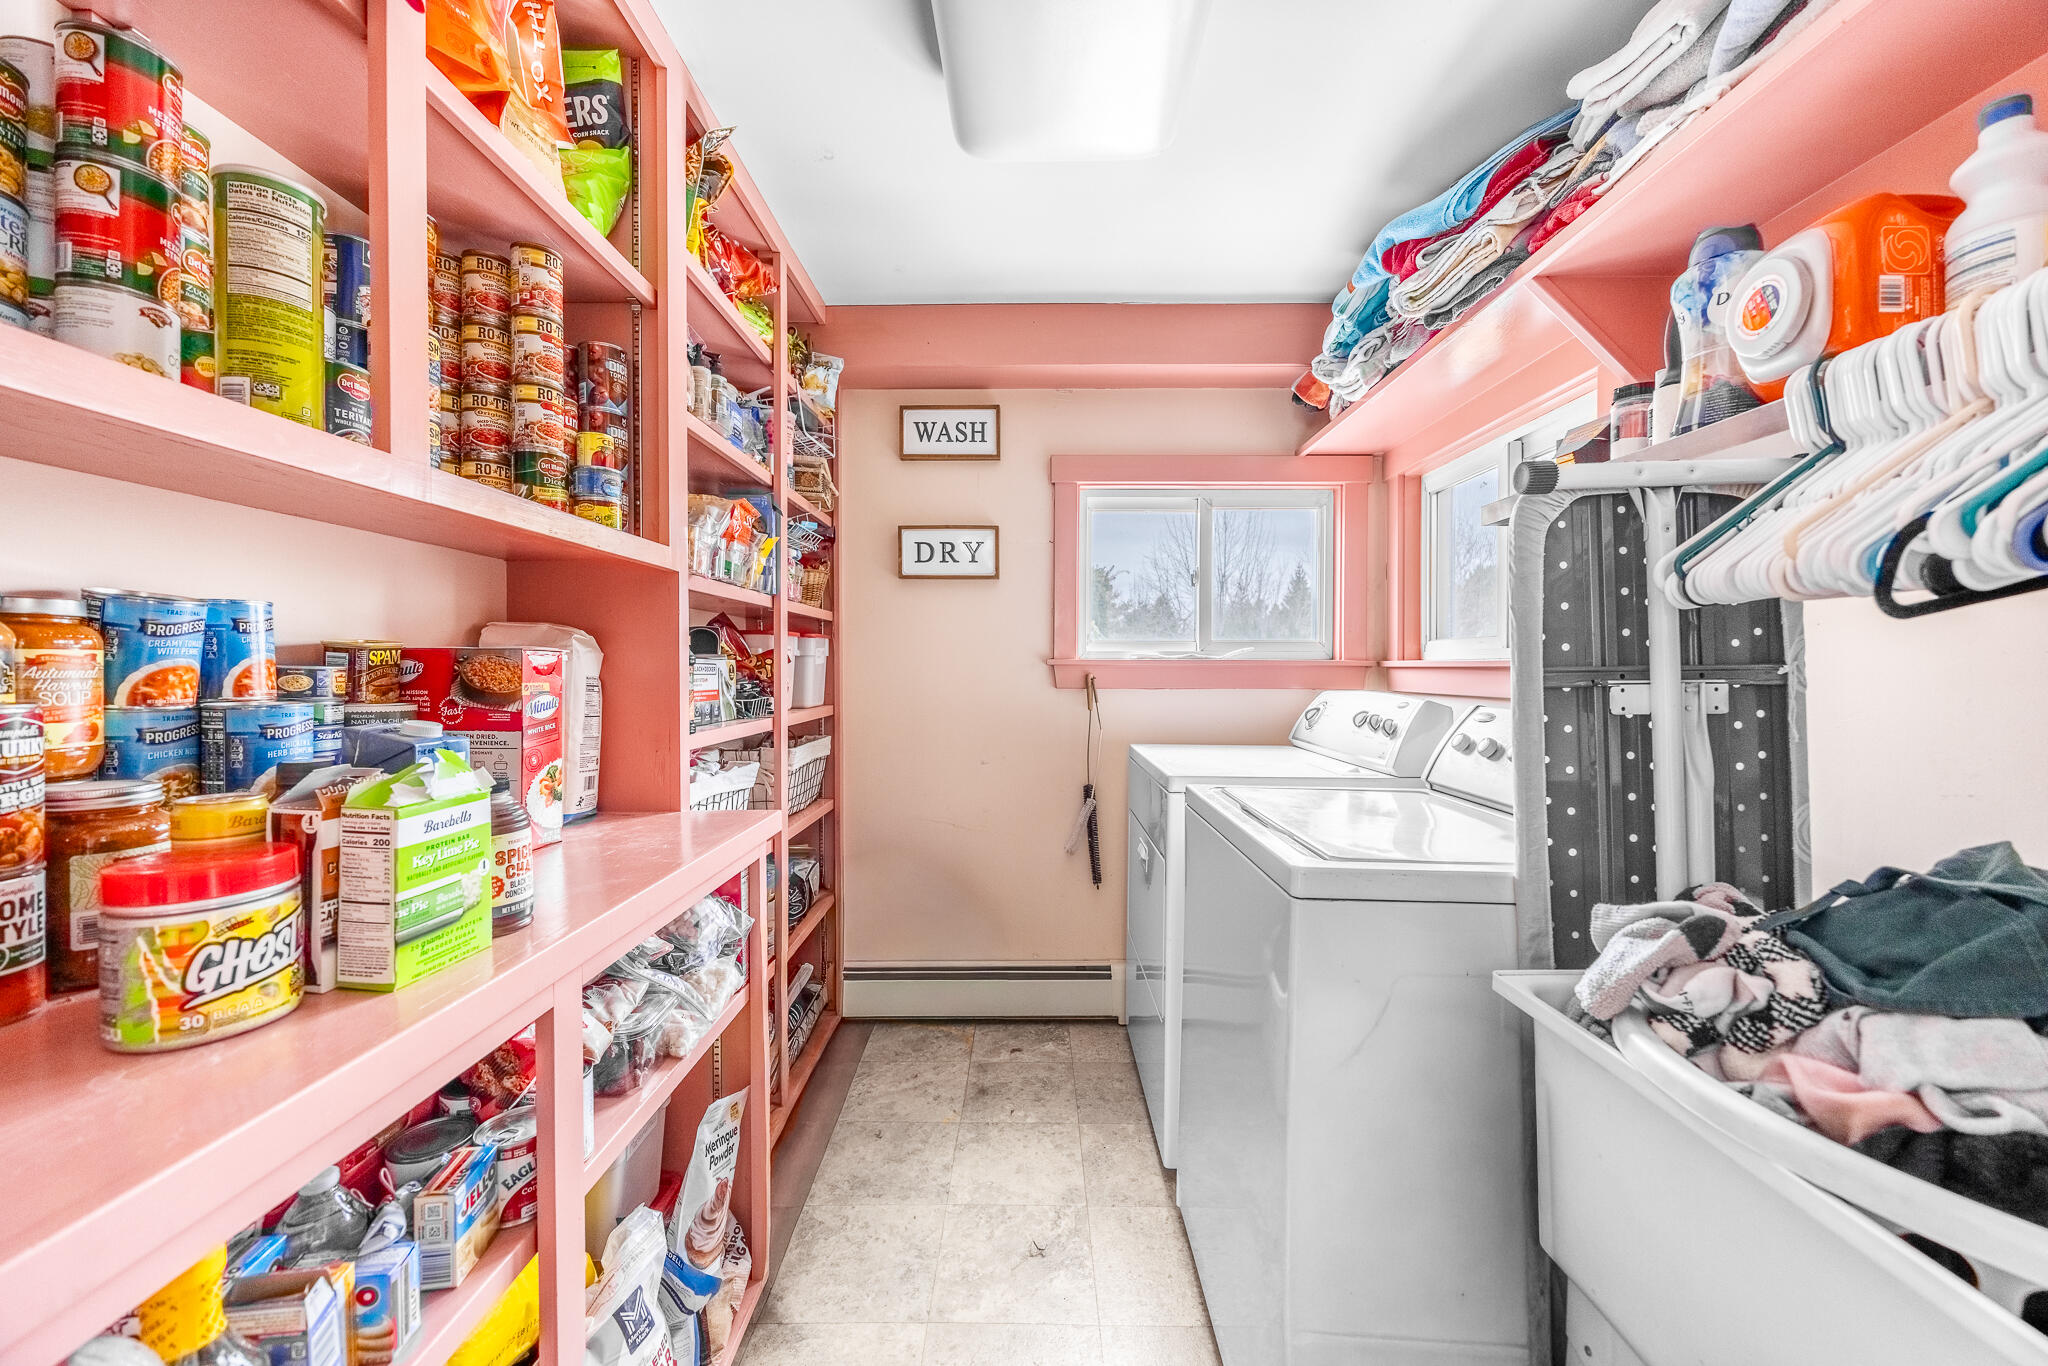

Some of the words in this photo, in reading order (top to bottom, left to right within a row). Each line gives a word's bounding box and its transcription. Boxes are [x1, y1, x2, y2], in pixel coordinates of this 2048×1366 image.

[228, 182, 269, 194] Nutrition
[272, 190, 297, 204] Facts
[228, 188, 253, 197] Datos
[256, 191, 268, 200] de
[296, 229, 312, 242] 150
[913, 421, 988, 443] WASH
[541, 462, 550, 470] Del
[544, 477, 566, 488] Diced
[914, 541, 984, 564] DRY
[148, 638, 183, 648] CREAMY
[157, 647, 180, 656] WITH
[368, 649, 401, 666] SPAM
[22, 666, 99, 679] Autumnal
[38, 691, 91, 707] SOUP
[528, 697, 559, 715] Minute
[441, 705, 464, 716] Fast
[528, 725, 544, 735] WHITE
[545, 722, 556, 731] RICE
[147, 749, 184, 760] CHICKEN
[267, 749, 287, 758] HERB
[424, 810, 472, 835] Barebells
[342, 838, 368, 846] Calories
[373, 838, 390, 847] 200
[426, 839, 456, 851] PROTEIN
[457, 833, 470, 842] BAR
[412, 853, 437, 868] Key
[437, 846, 464, 861] Lime
[464, 838, 480, 852] Pie
[180, 1013, 205, 1030] 30
[213, 997, 264, 1019] BCAA
[705, 1126, 738, 1158] Meringue
[708, 1142, 735, 1171] Powder
